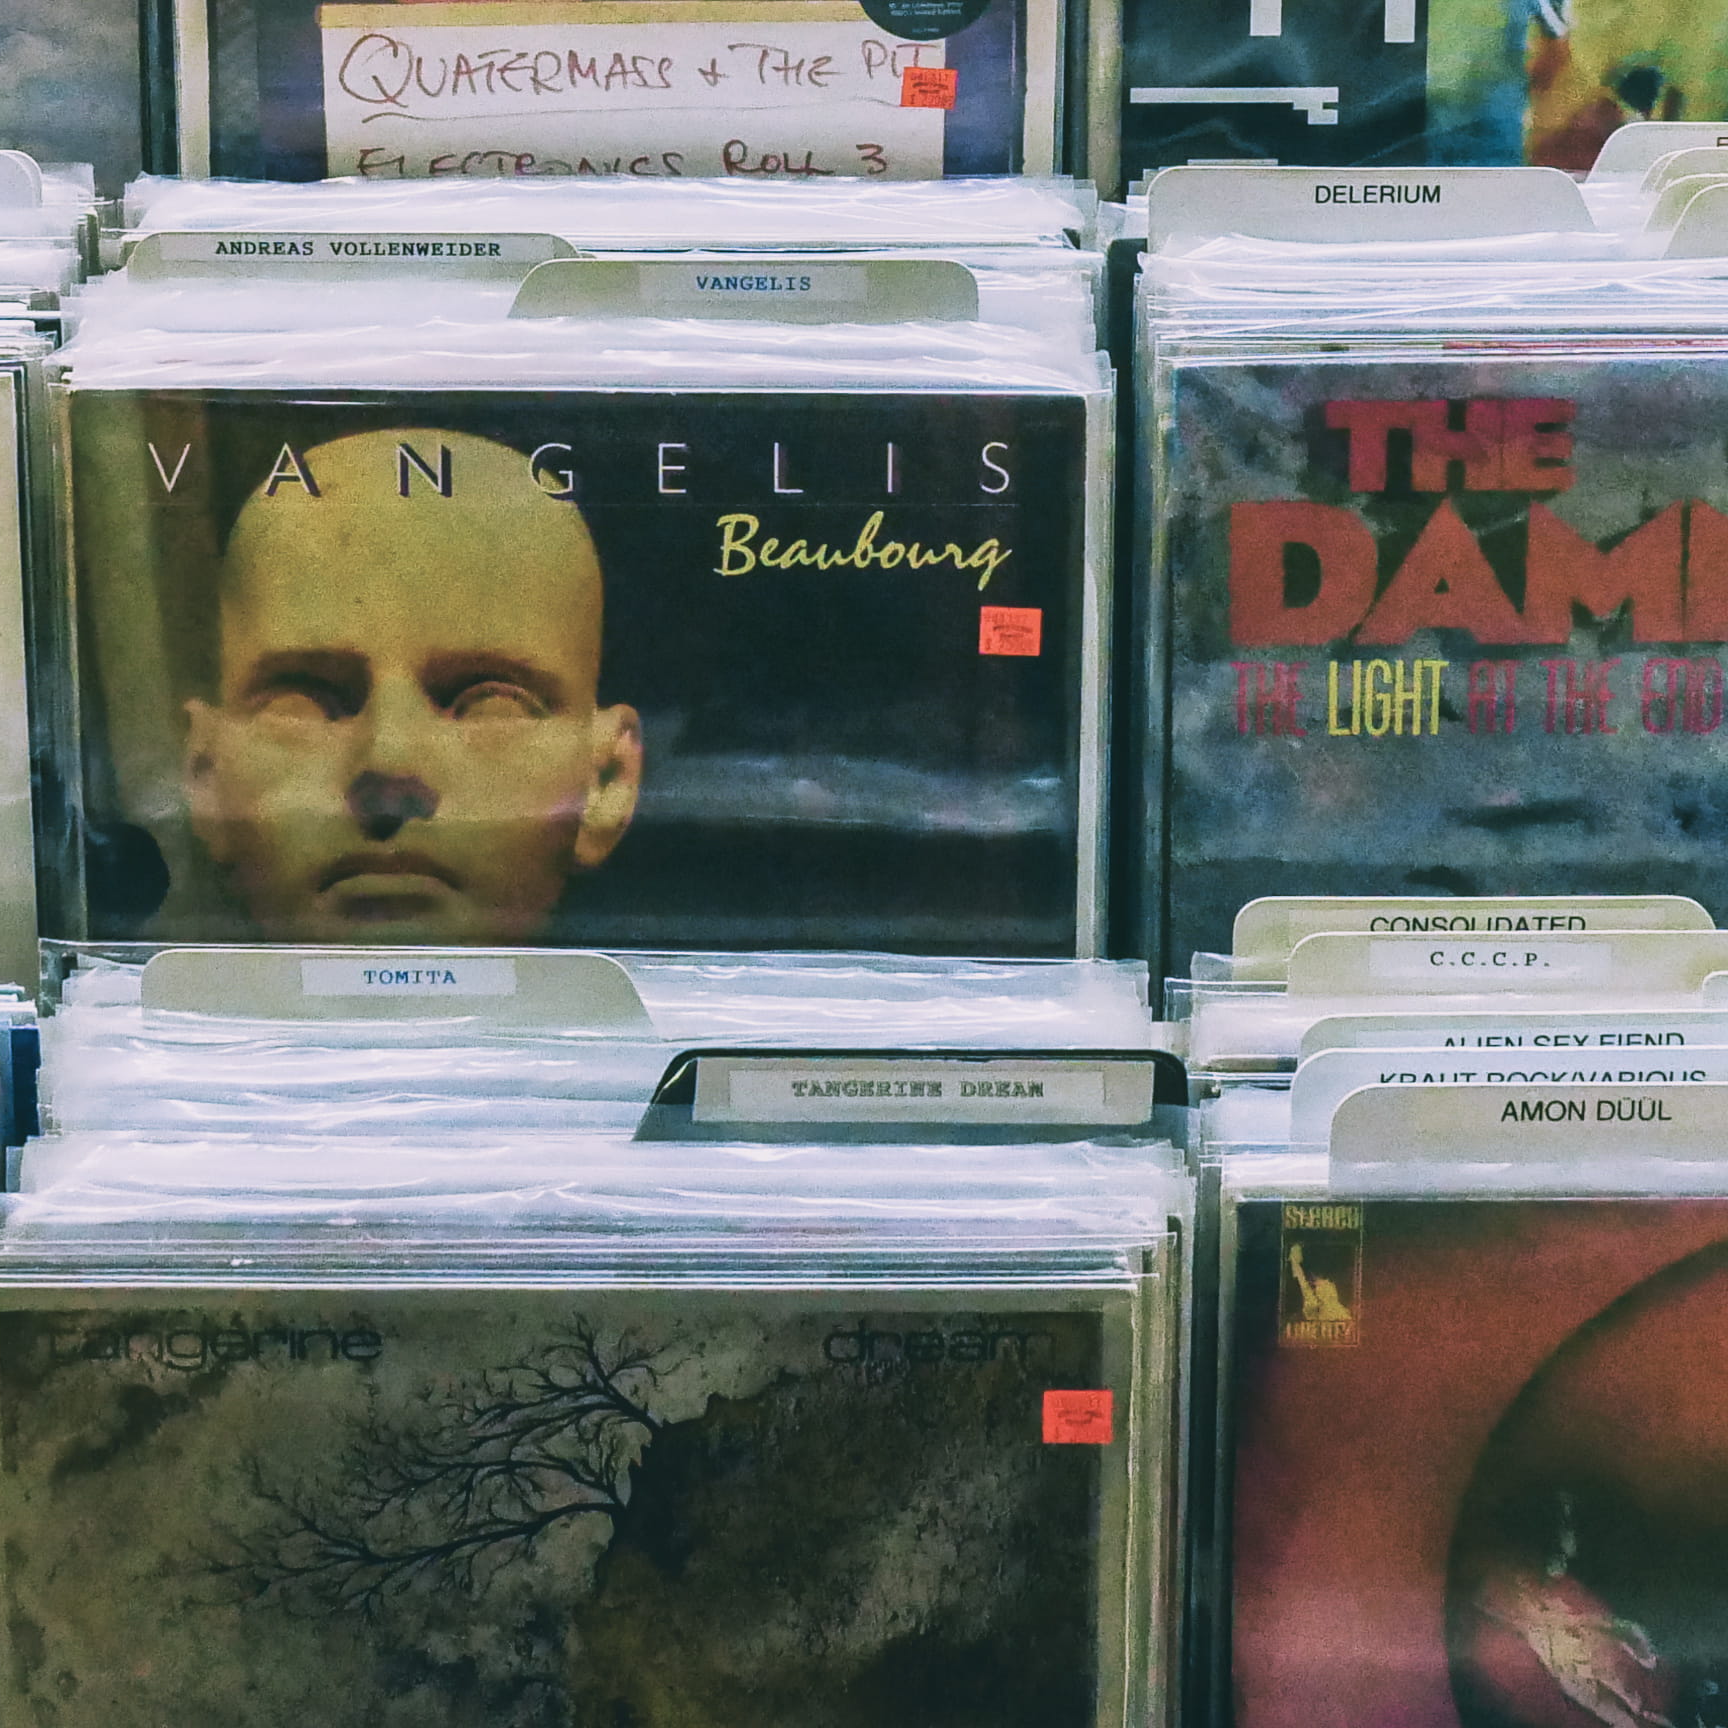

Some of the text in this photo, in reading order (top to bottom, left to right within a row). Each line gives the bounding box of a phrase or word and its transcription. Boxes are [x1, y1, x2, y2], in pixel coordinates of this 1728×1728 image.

[338, 33, 942, 106] QUATERMASS THE PIT
[722, 138, 890, 177] ROLL 3
[1315, 184, 1441, 204] DELERIUM
[215, 241, 502, 257] ANDREAS VOLLENWEIDER
[696, 275, 811, 292] VANGELIS
[1324, 396, 1577, 494] THE
[145, 440, 1014, 500] VANGELIS
[712, 511, 1012, 592] Beaubourg
[1325, 655, 1450, 736] LIGHT
[1369, 915, 1587, 931] CONSOLIDATED
[1429, 950, 1551, 967] C.C.C.P.
[363, 969, 457, 985] TOMITA
[791, 1079, 1044, 1099] TANGERINE DREAM
[1500, 1099, 1673, 1123] AMON DÜÜL
